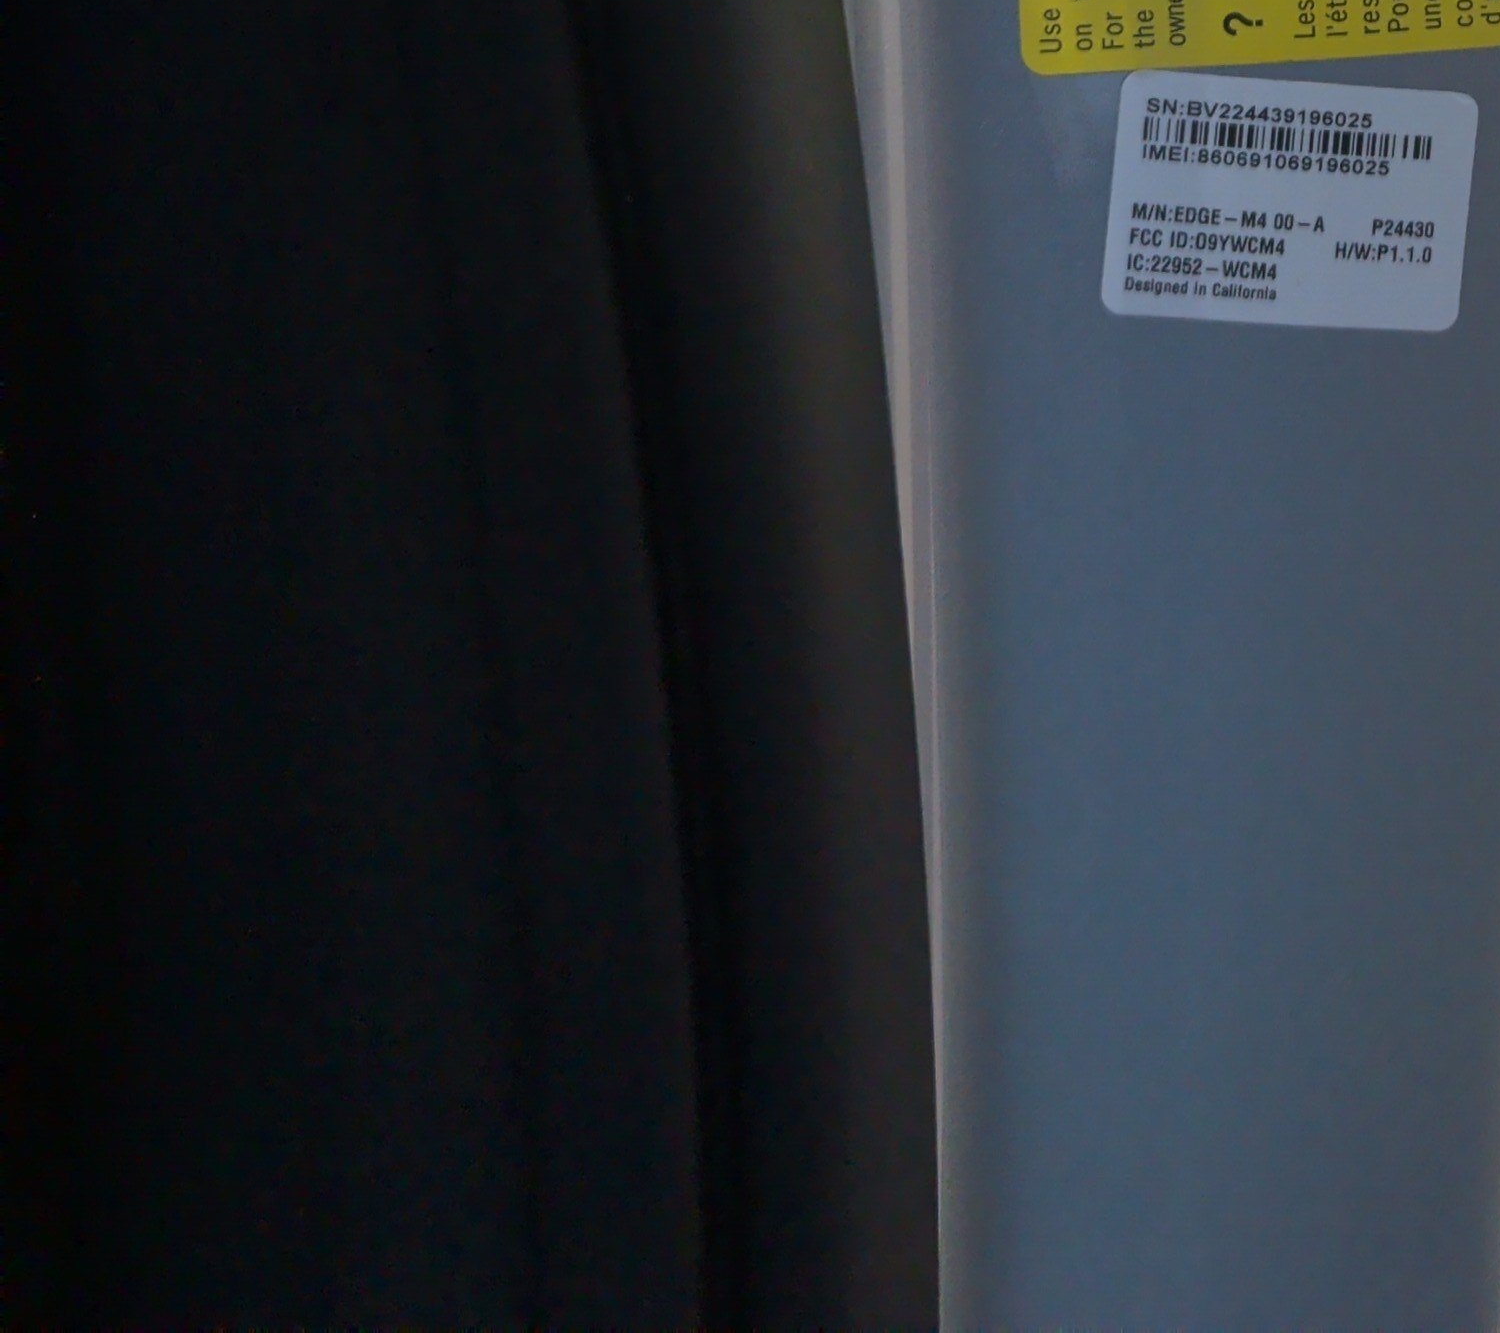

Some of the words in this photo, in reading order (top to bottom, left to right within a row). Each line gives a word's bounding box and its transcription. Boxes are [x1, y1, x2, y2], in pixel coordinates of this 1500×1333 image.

[1038, 7, 1063, 54] Use
[1100, 10, 1124, 50] For
[1145, 96, 1372, 129] SN:BV224439196025
[1141, 142, 1390, 176] IMEI:860691069196025
[1128, 226, 1163, 248] FCC
[1370, 217, 1435, 239] P24430
[1333, 240, 1432, 264] H/W:P1.1.0
[1123, 275, 1189, 296] Designed
[1192, 280, 1207, 296] in
[1210, 281, 1277, 301] California
